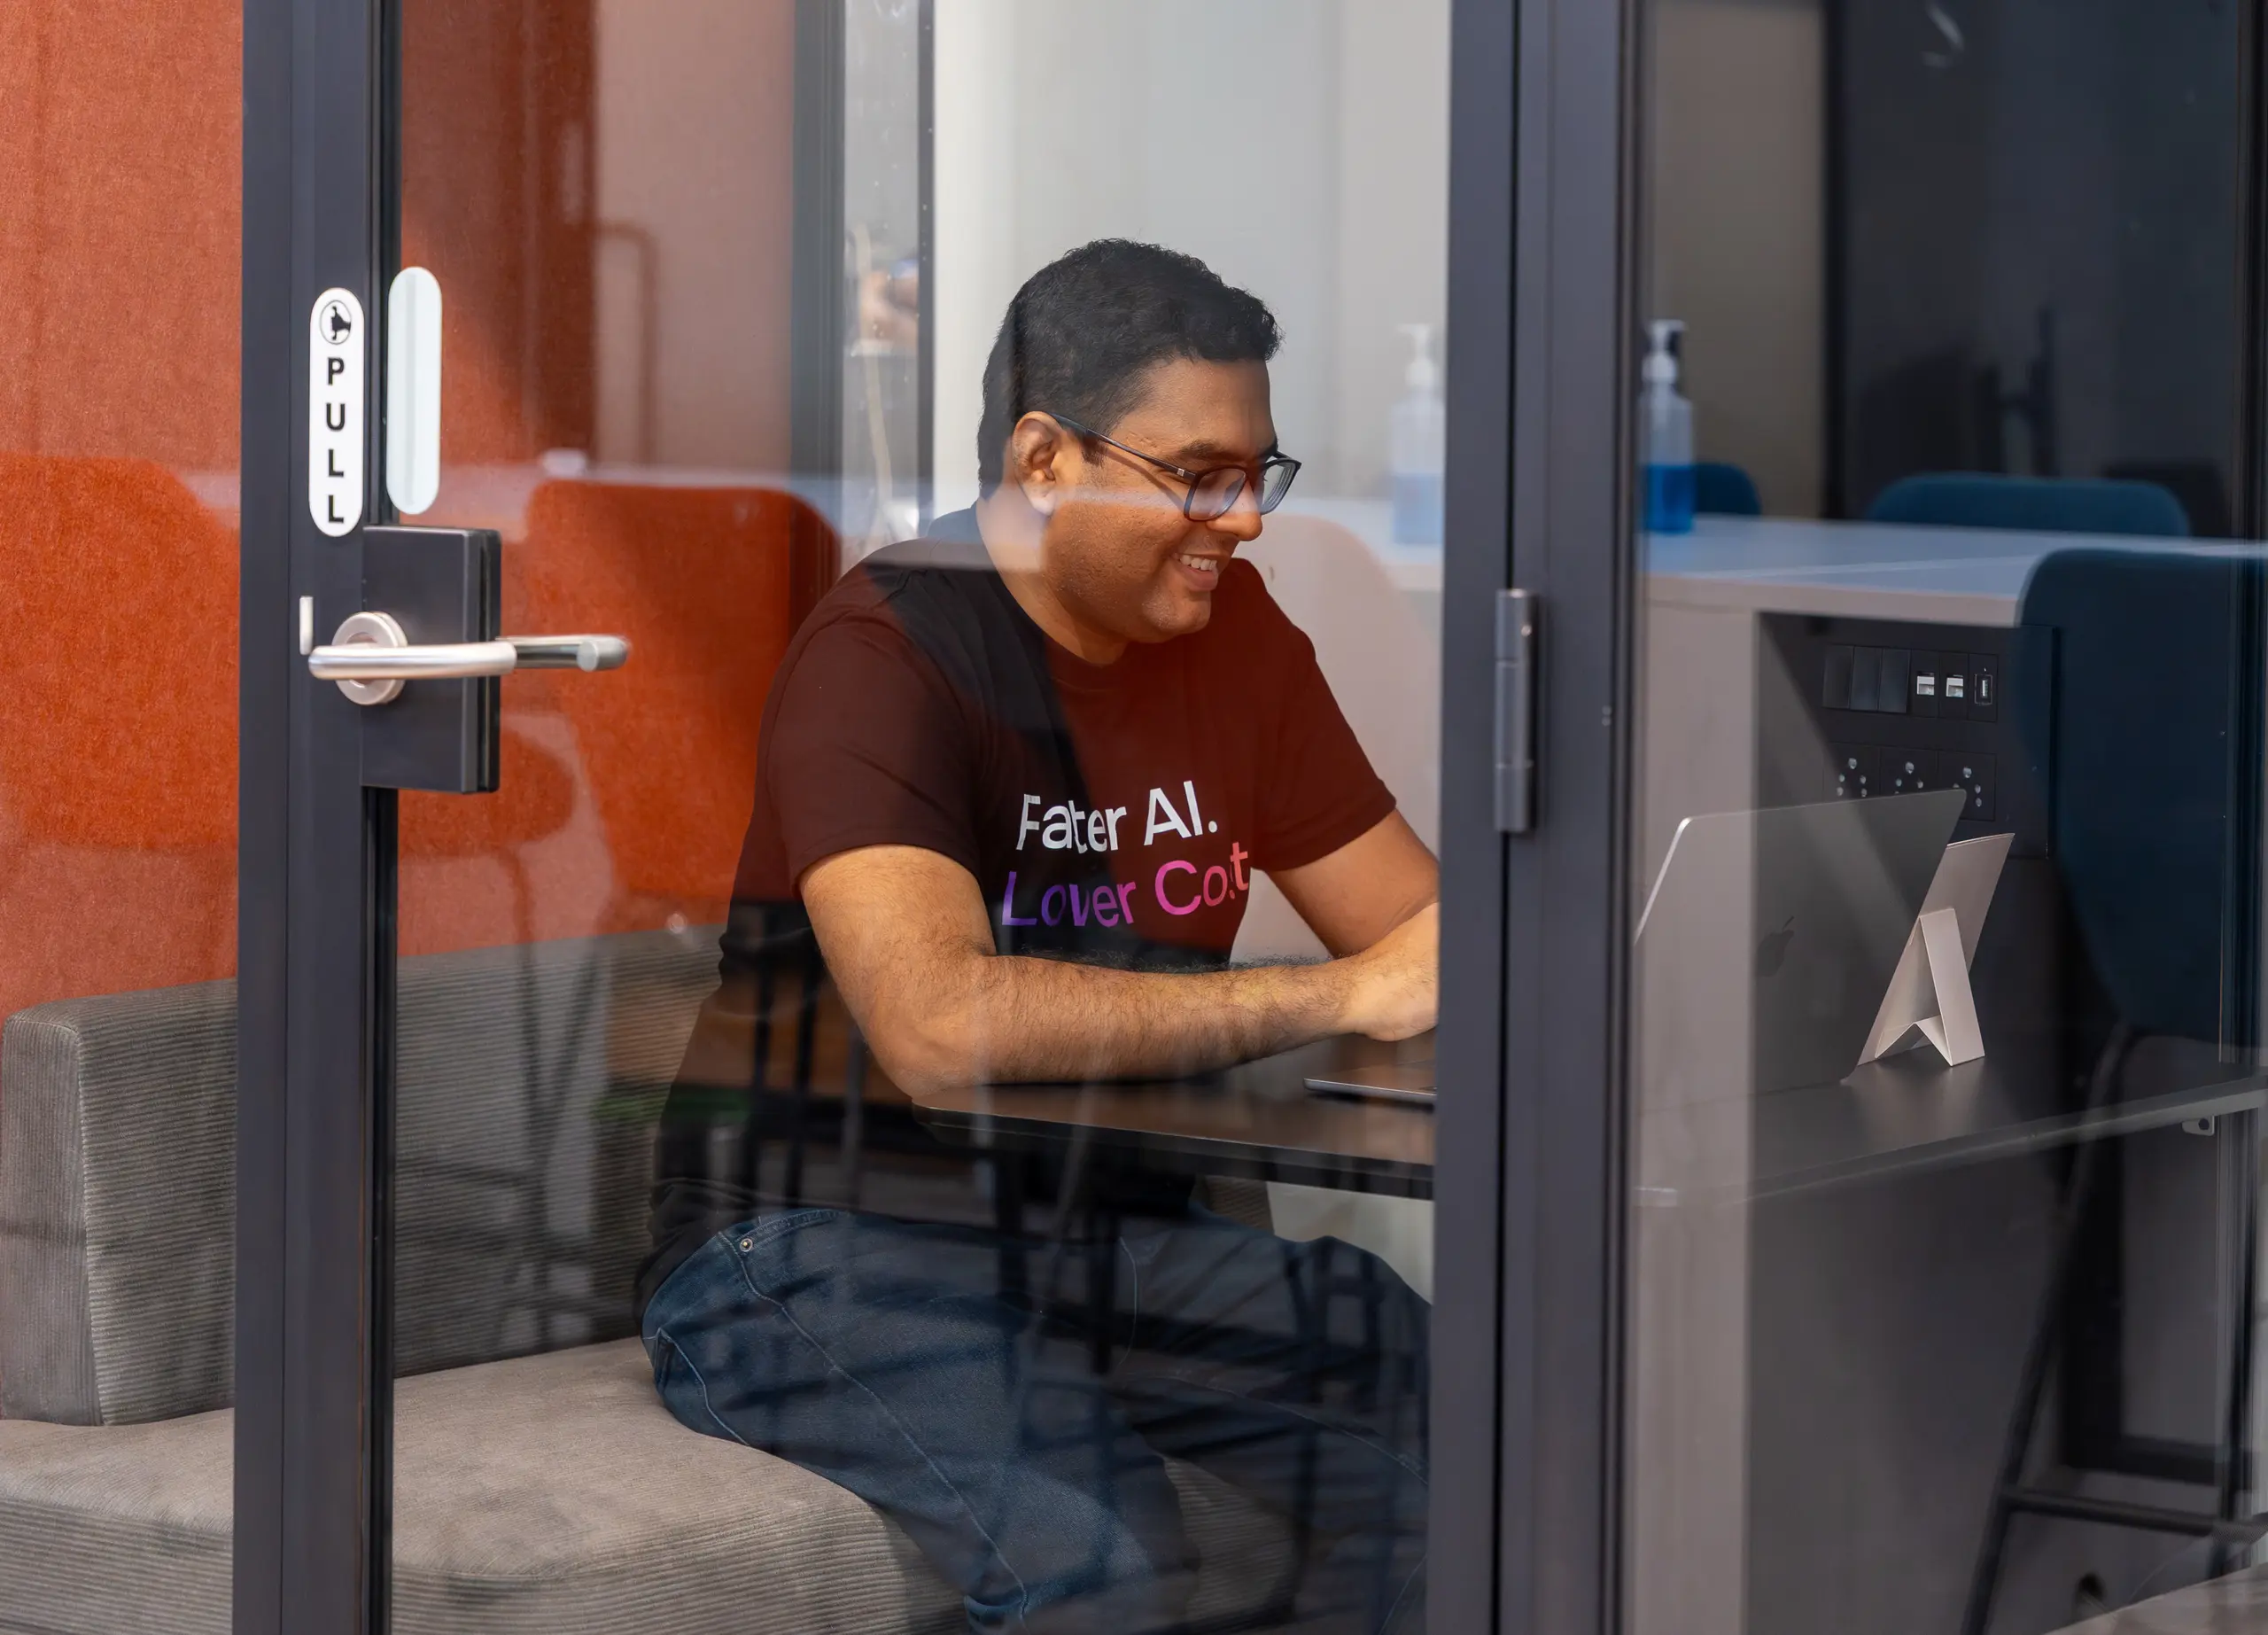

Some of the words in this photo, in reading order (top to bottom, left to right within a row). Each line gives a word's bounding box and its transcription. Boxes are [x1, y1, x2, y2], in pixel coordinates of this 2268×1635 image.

[325, 356, 346, 524] PULL
[1015, 793, 1127, 854] Fater
[1143, 780, 1218, 846] AI.
